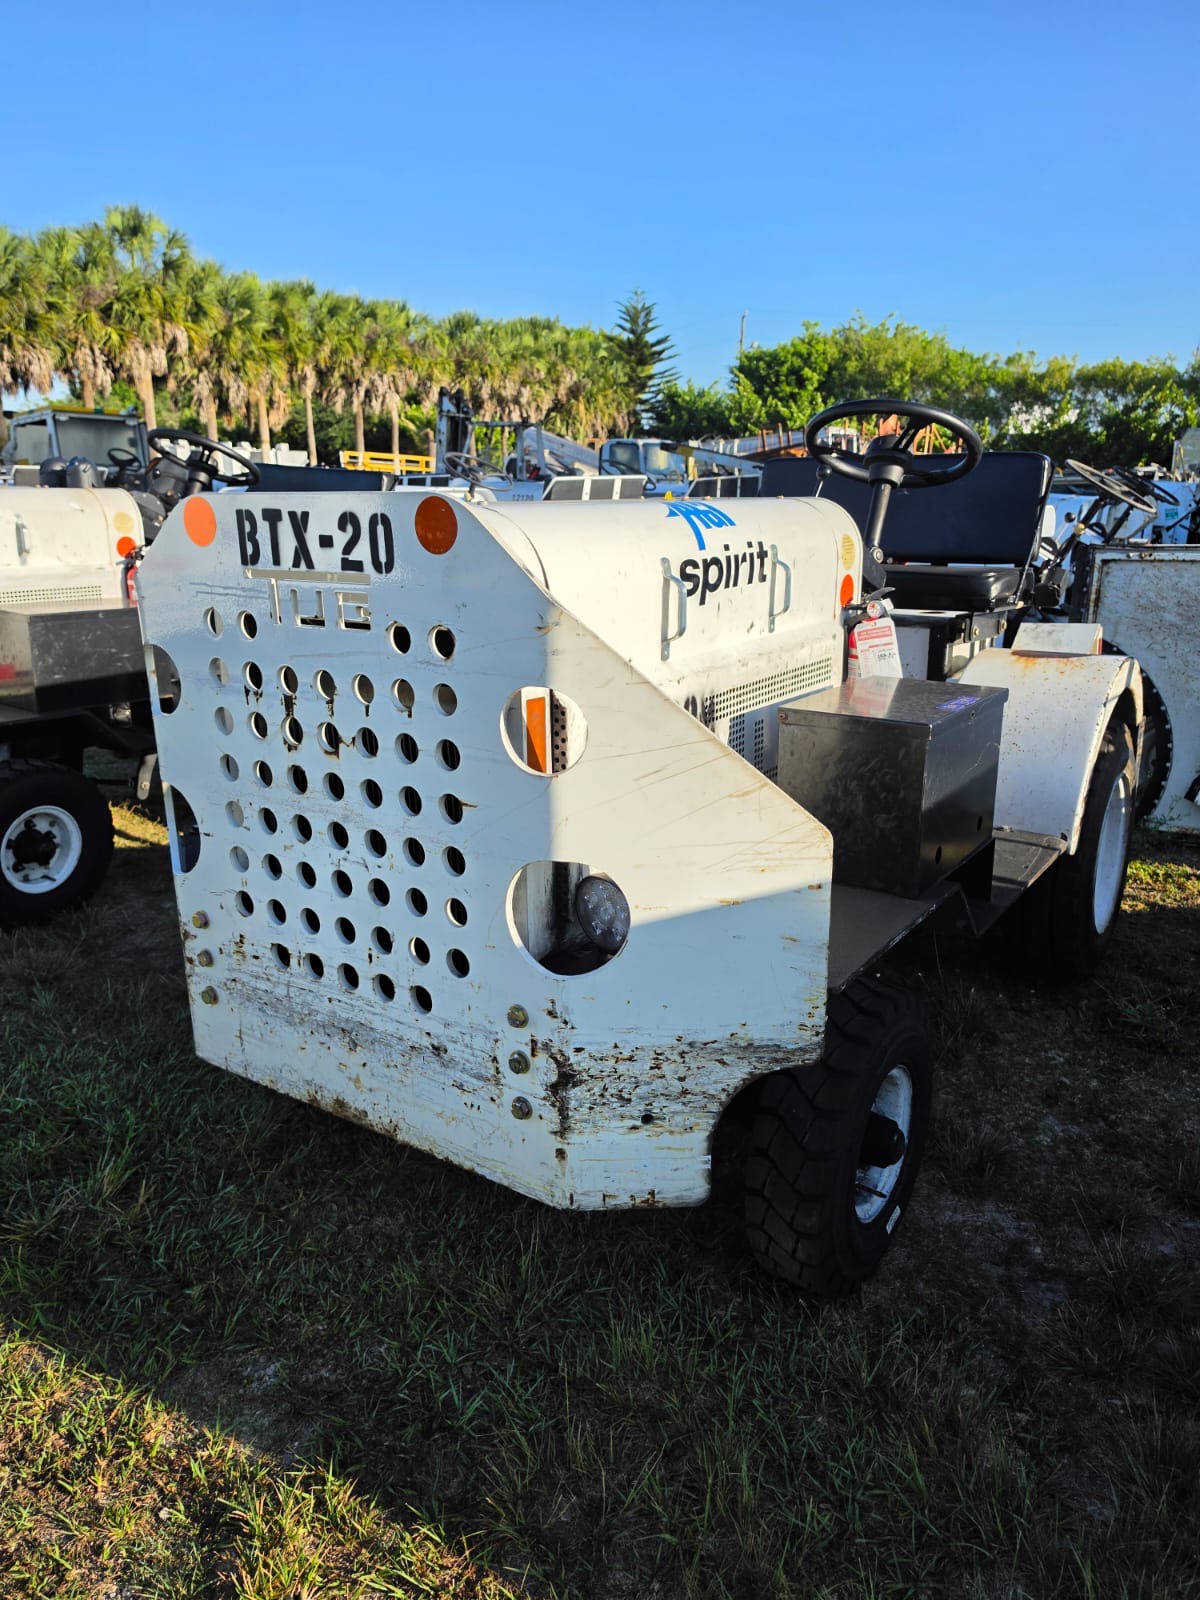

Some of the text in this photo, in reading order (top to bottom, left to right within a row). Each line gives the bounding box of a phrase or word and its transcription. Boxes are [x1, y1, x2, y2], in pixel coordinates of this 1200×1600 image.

[236, 508, 395, 574] BTX-20
[679, 541, 768, 606] spirit
[244, 568, 372, 631] TUG
